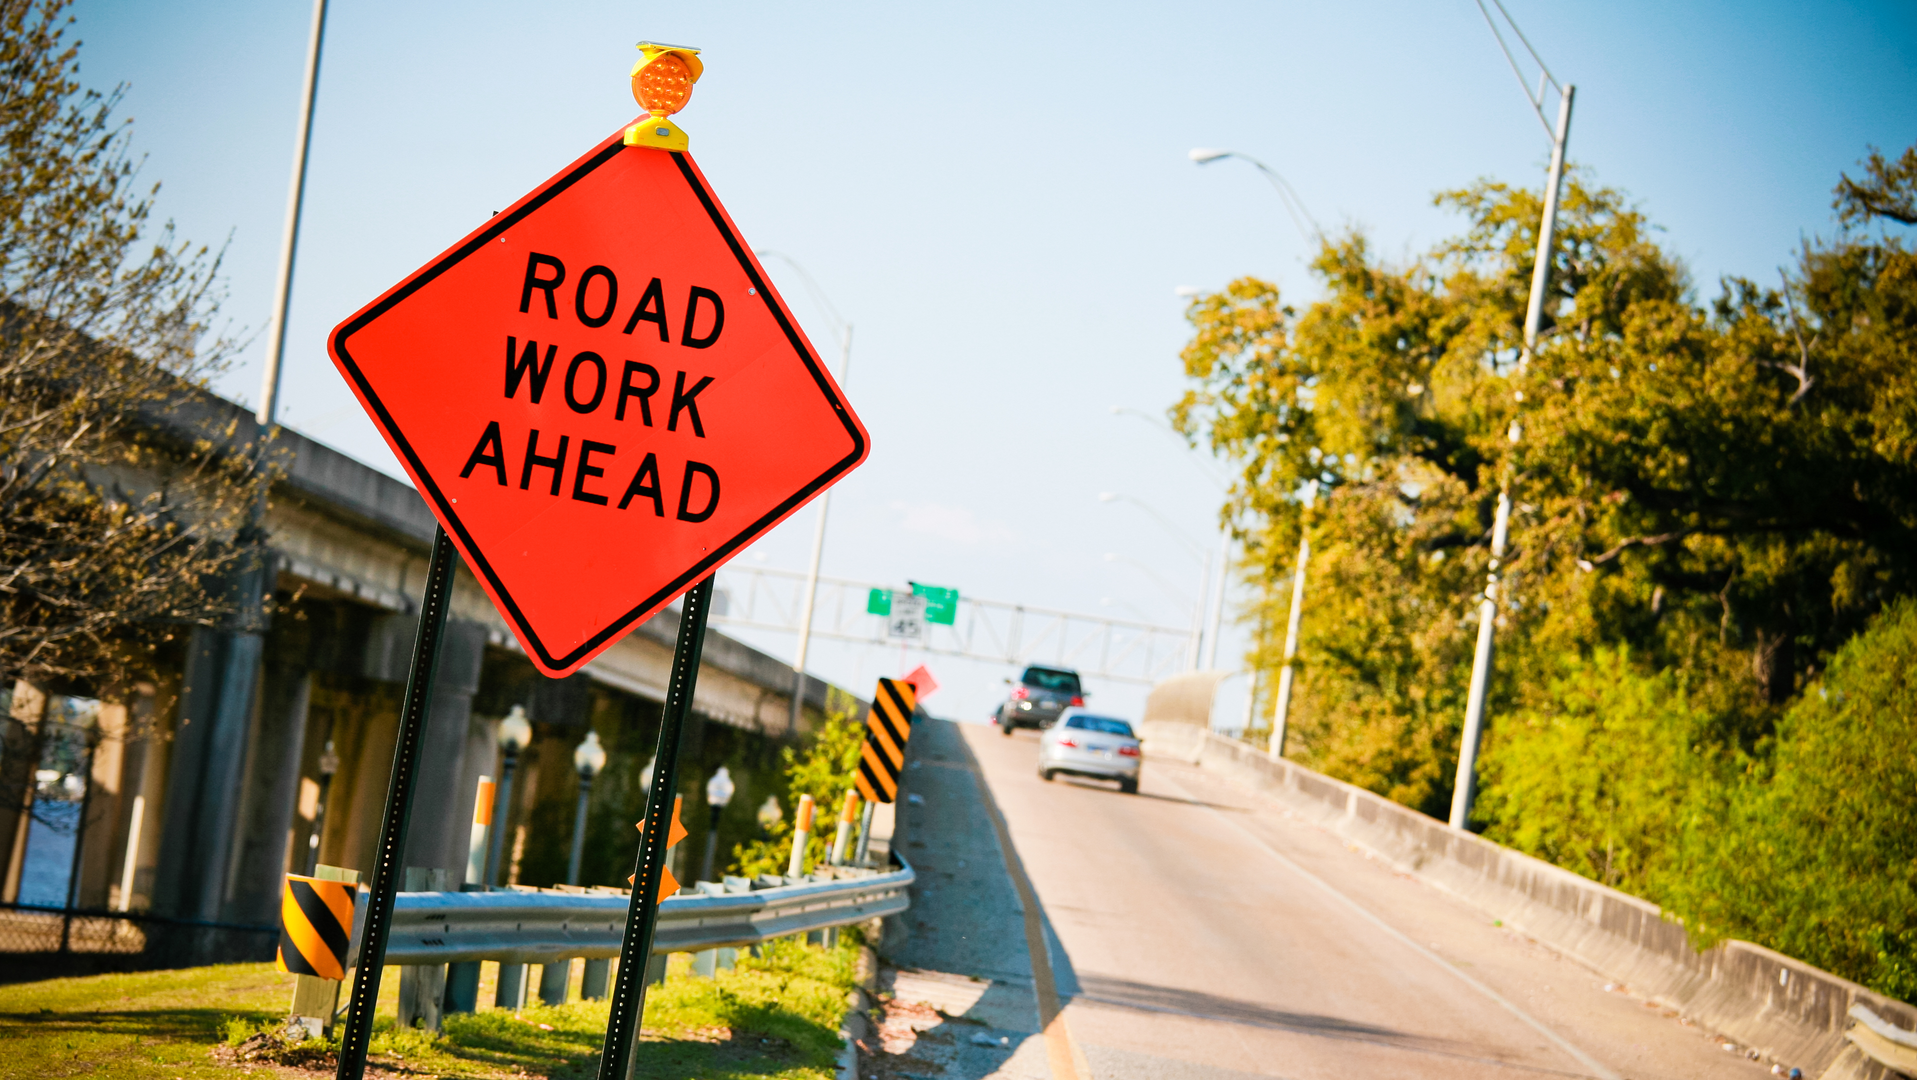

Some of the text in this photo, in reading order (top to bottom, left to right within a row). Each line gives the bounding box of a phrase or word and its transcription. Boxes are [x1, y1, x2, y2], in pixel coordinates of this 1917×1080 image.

[519, 252, 725, 349] ROAD
[504, 335, 716, 439] WORK
[459, 420, 721, 523] AHEAD
